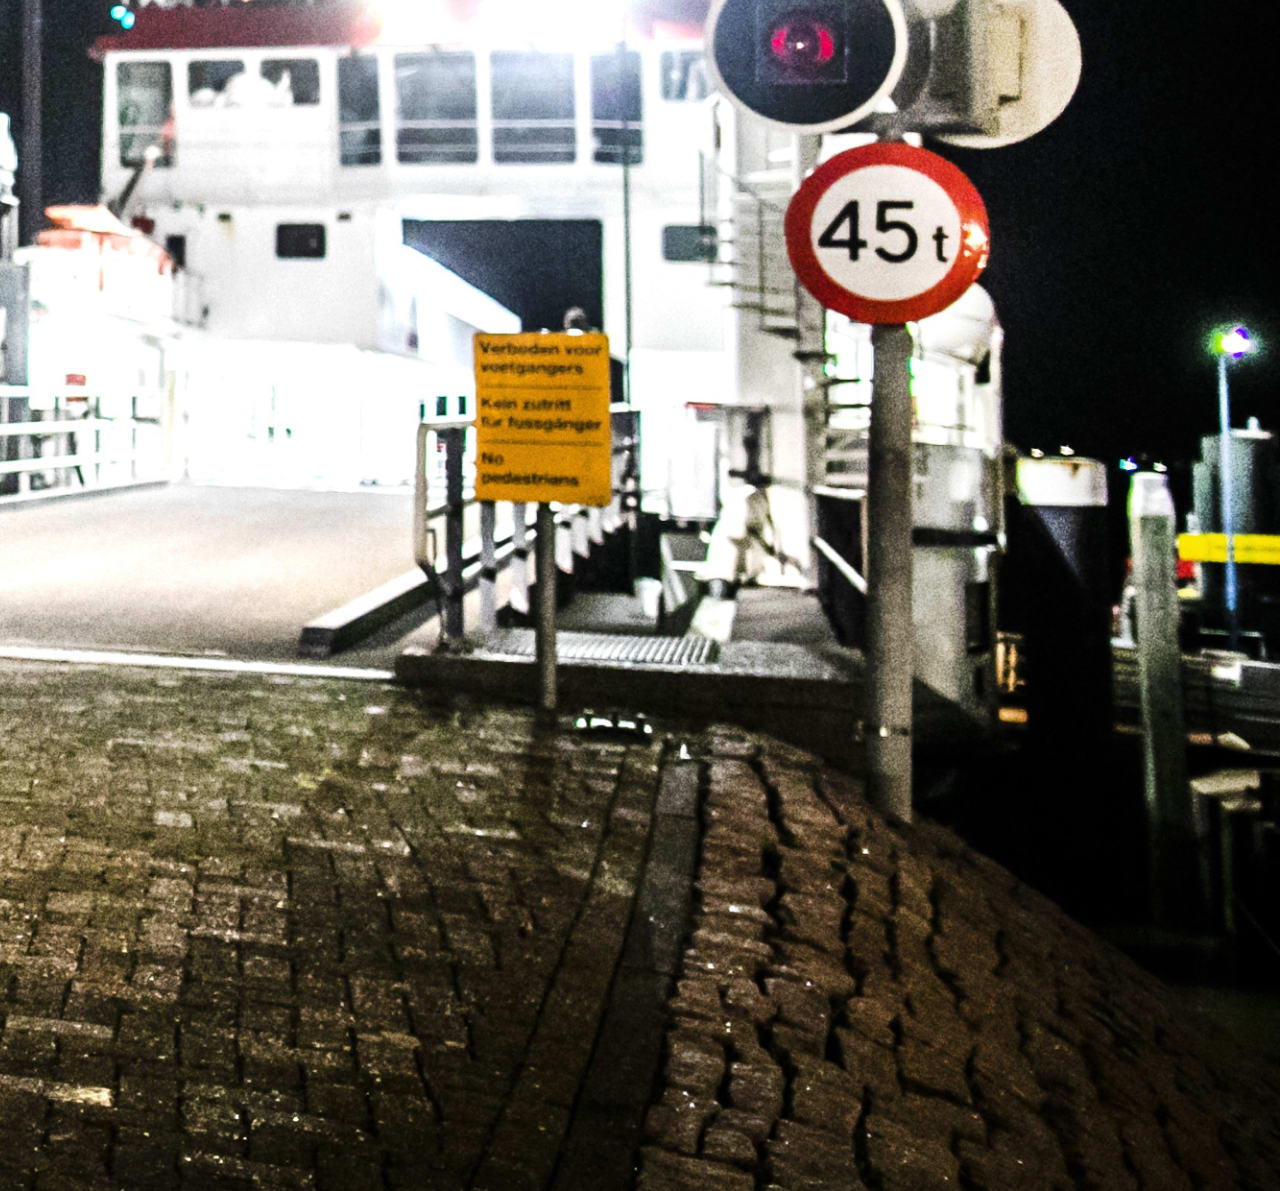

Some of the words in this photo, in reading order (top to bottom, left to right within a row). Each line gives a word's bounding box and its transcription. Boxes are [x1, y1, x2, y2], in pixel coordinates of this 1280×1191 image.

[480, 342, 560, 356] Verboden
[565, 345, 602, 356] voor
[480, 363, 584, 376] voetgangers
[481, 452, 504, 466] No
[481, 472, 580, 488] pedestrians
